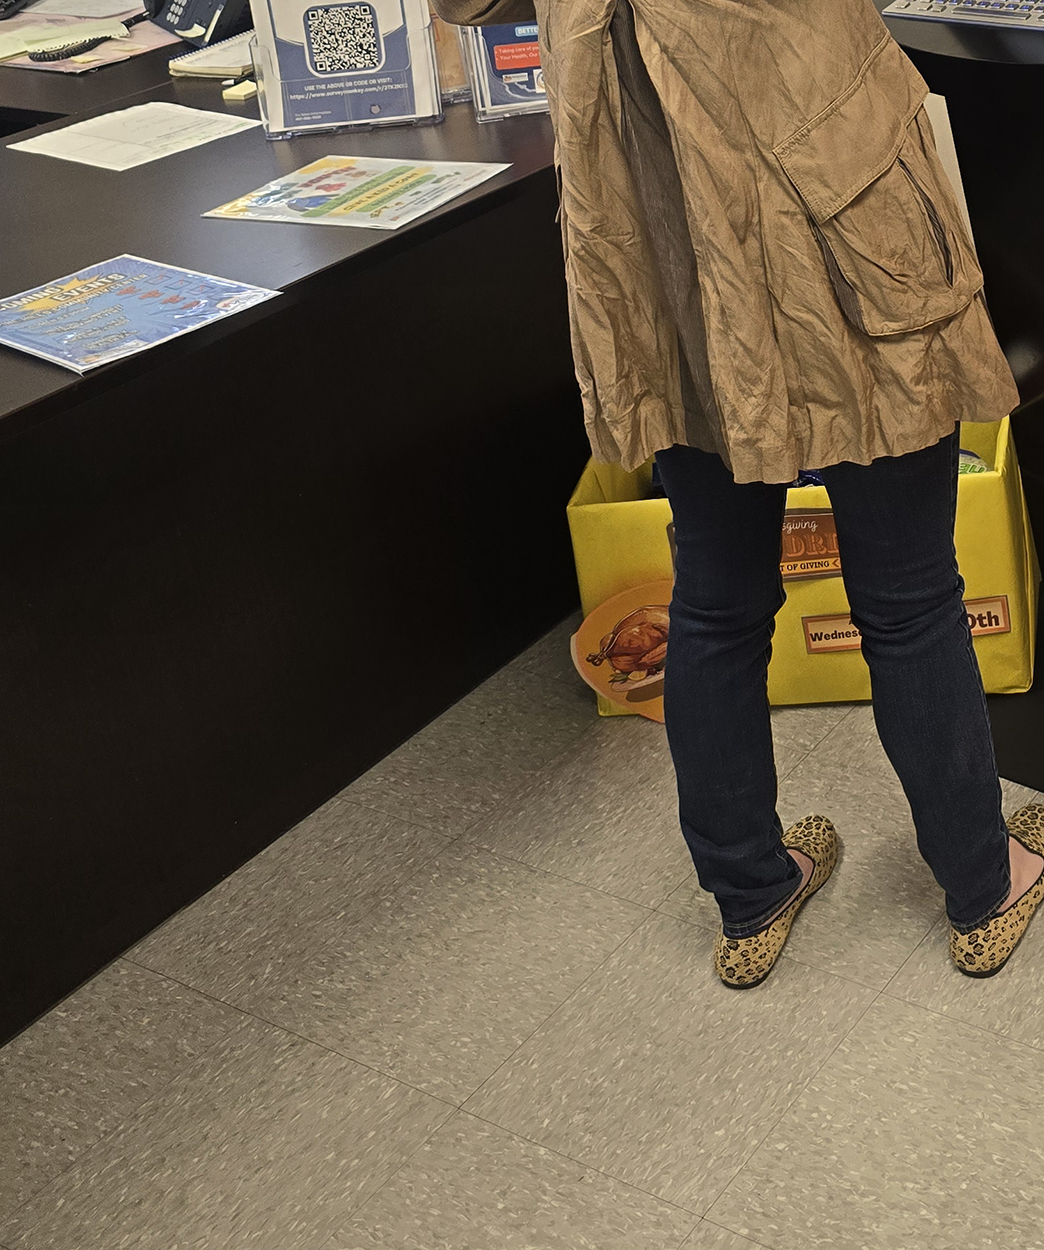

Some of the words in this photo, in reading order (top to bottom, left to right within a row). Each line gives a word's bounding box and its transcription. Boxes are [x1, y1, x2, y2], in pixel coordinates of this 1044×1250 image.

[0, 285, 62, 311] OMING
[52, 273, 125, 301] EVENTS
[786, 563, 799, 571] OF
[800, 560, 830, 570] GIVING
